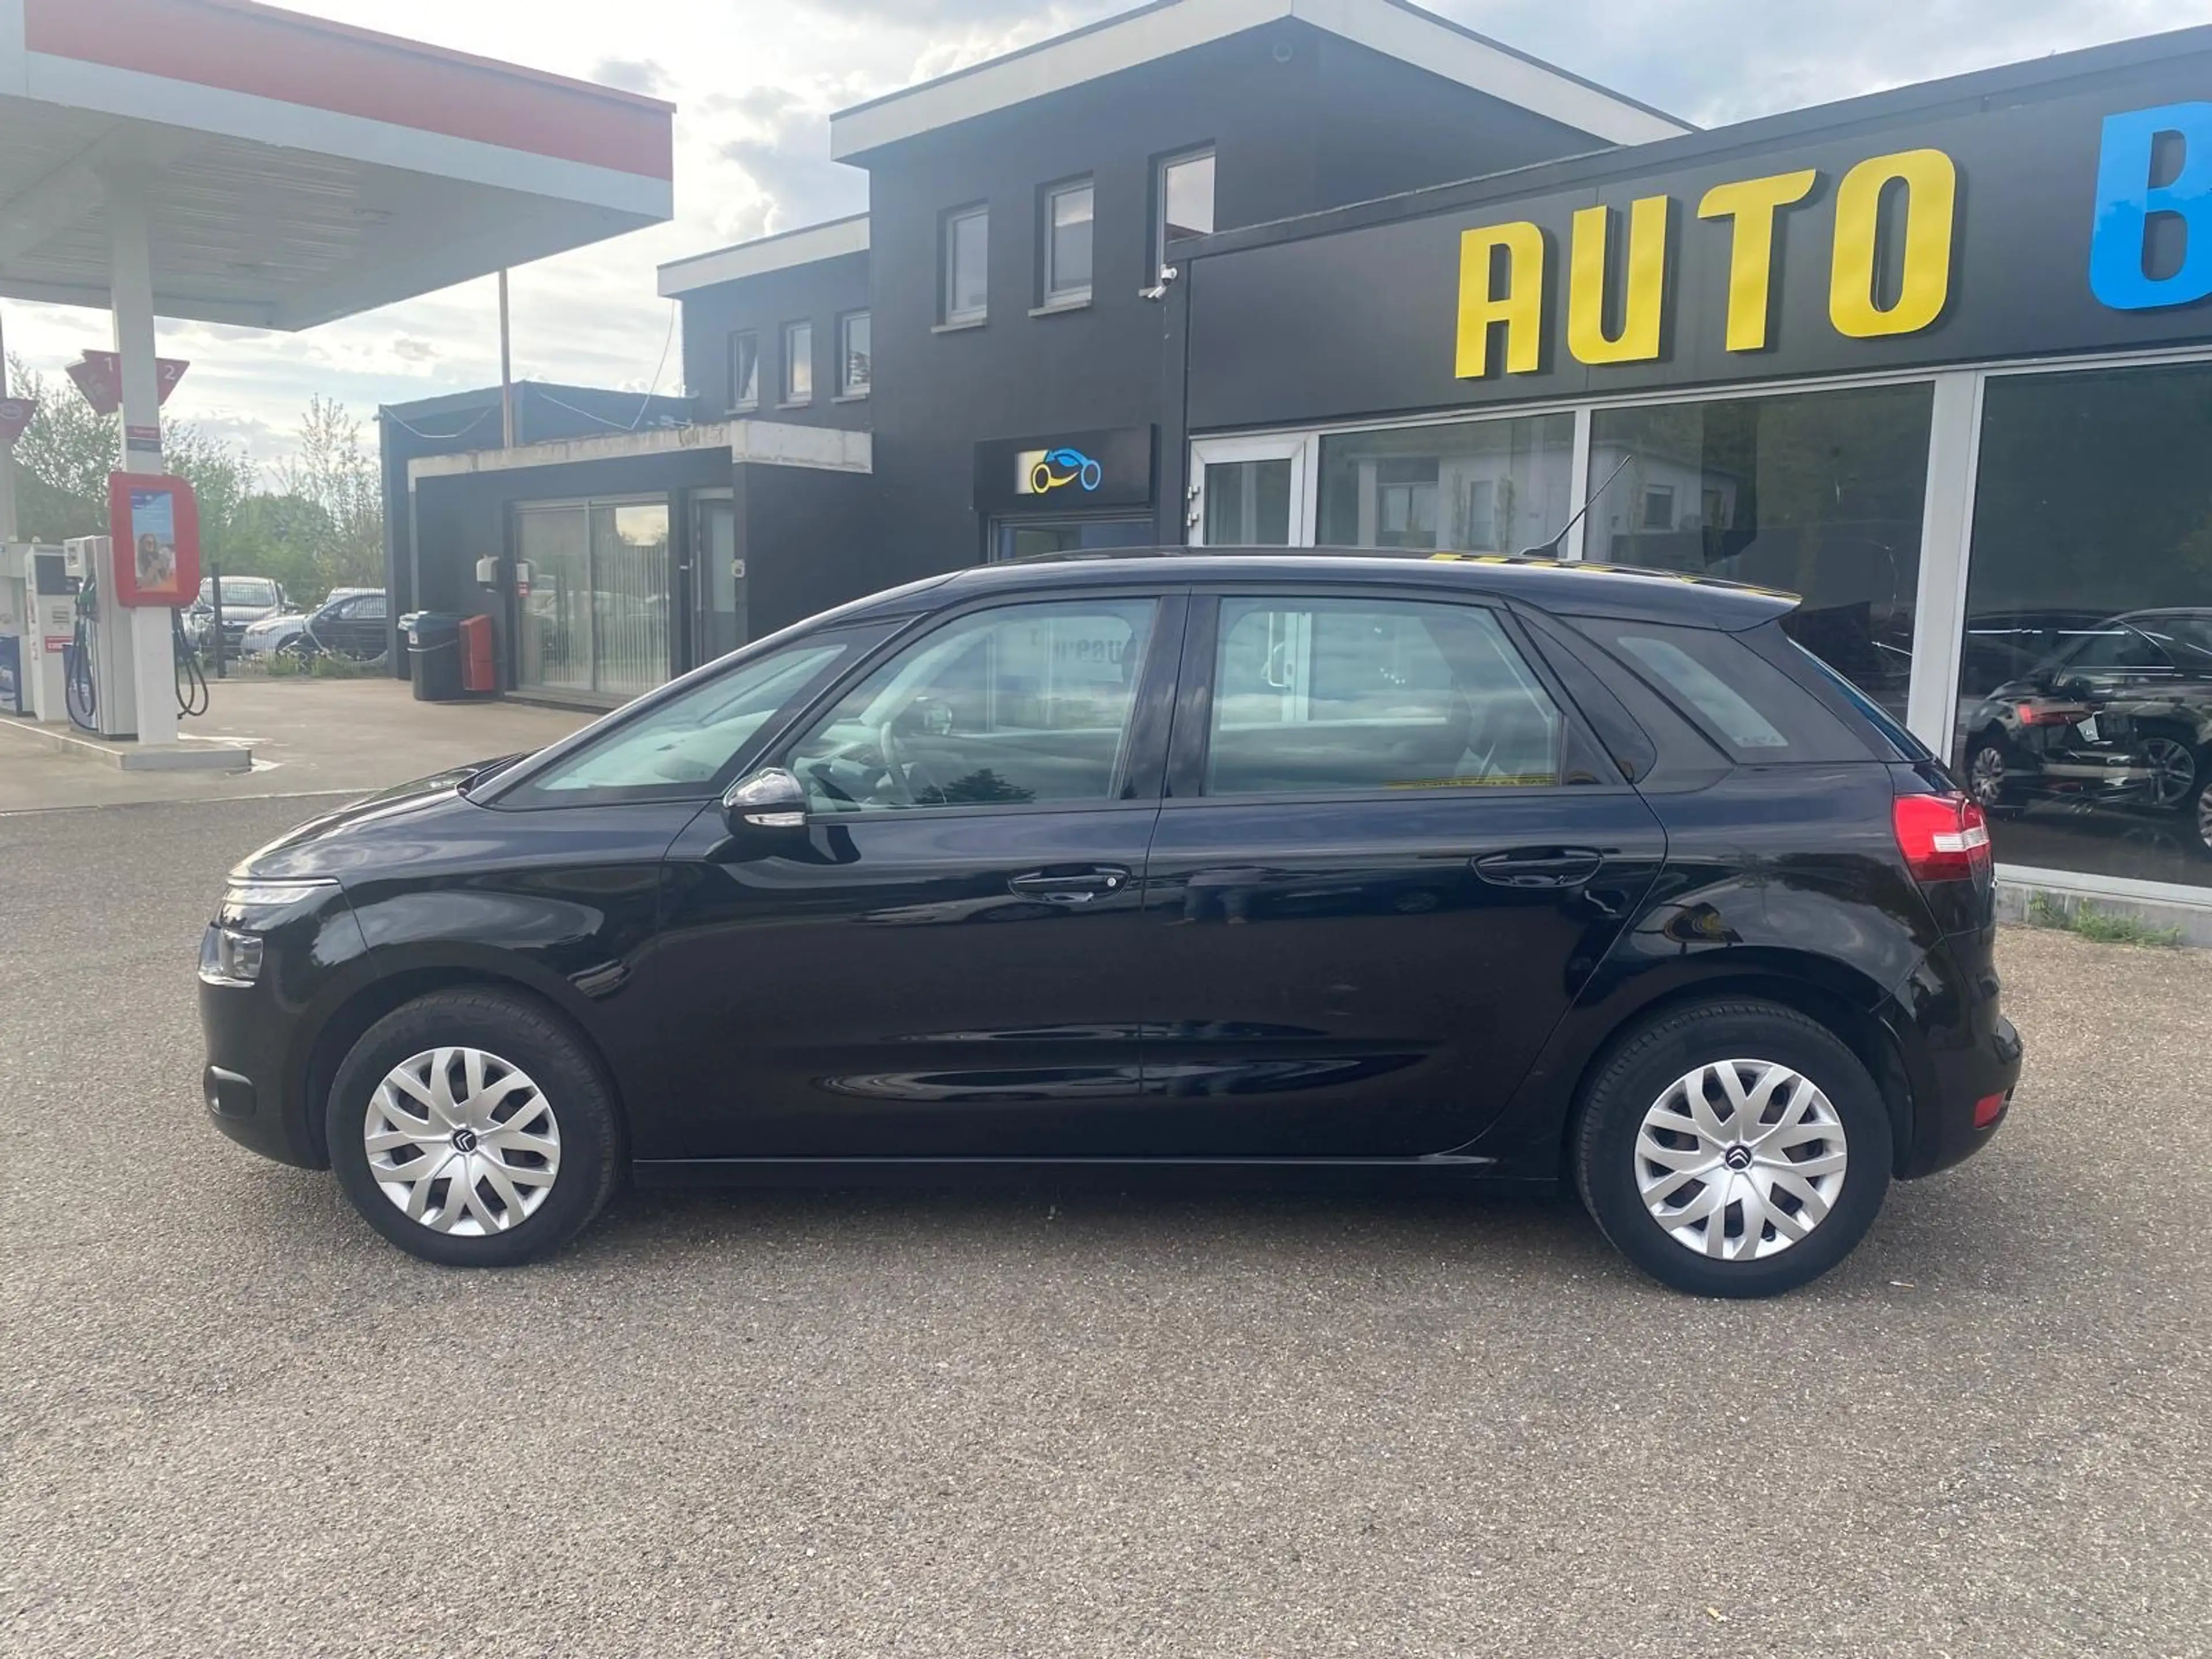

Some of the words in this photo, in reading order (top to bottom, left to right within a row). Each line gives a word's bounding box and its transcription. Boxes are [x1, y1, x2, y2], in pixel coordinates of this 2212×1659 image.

[1455, 148, 1954, 378] AUTO
[103, 357, 113, 372] 1
[163, 365, 176, 380] 2
